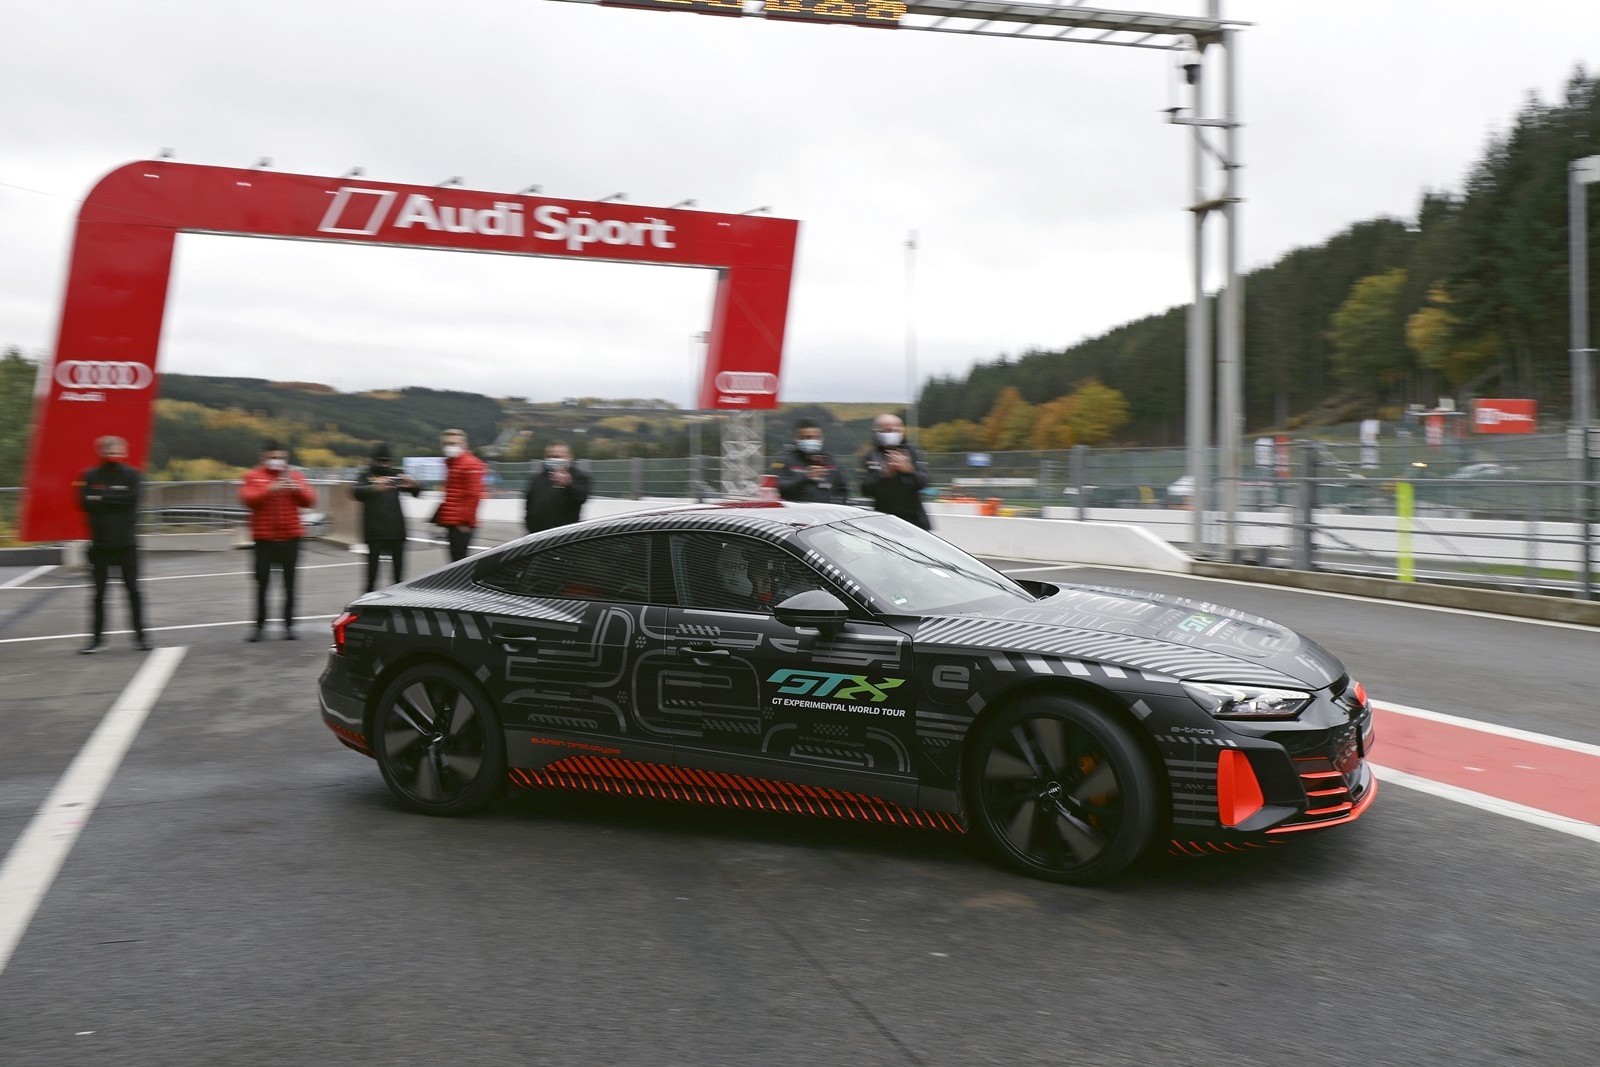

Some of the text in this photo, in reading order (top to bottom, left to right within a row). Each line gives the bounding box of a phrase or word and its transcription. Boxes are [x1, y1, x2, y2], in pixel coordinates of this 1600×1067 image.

[393, 193, 676, 251] Audi Sport
[766, 668, 906, 702] GTX
[771, 697, 906, 718] GT EXPERIMENTAL WORLD TOUR
[1171, 727, 1214, 735] e-tron
